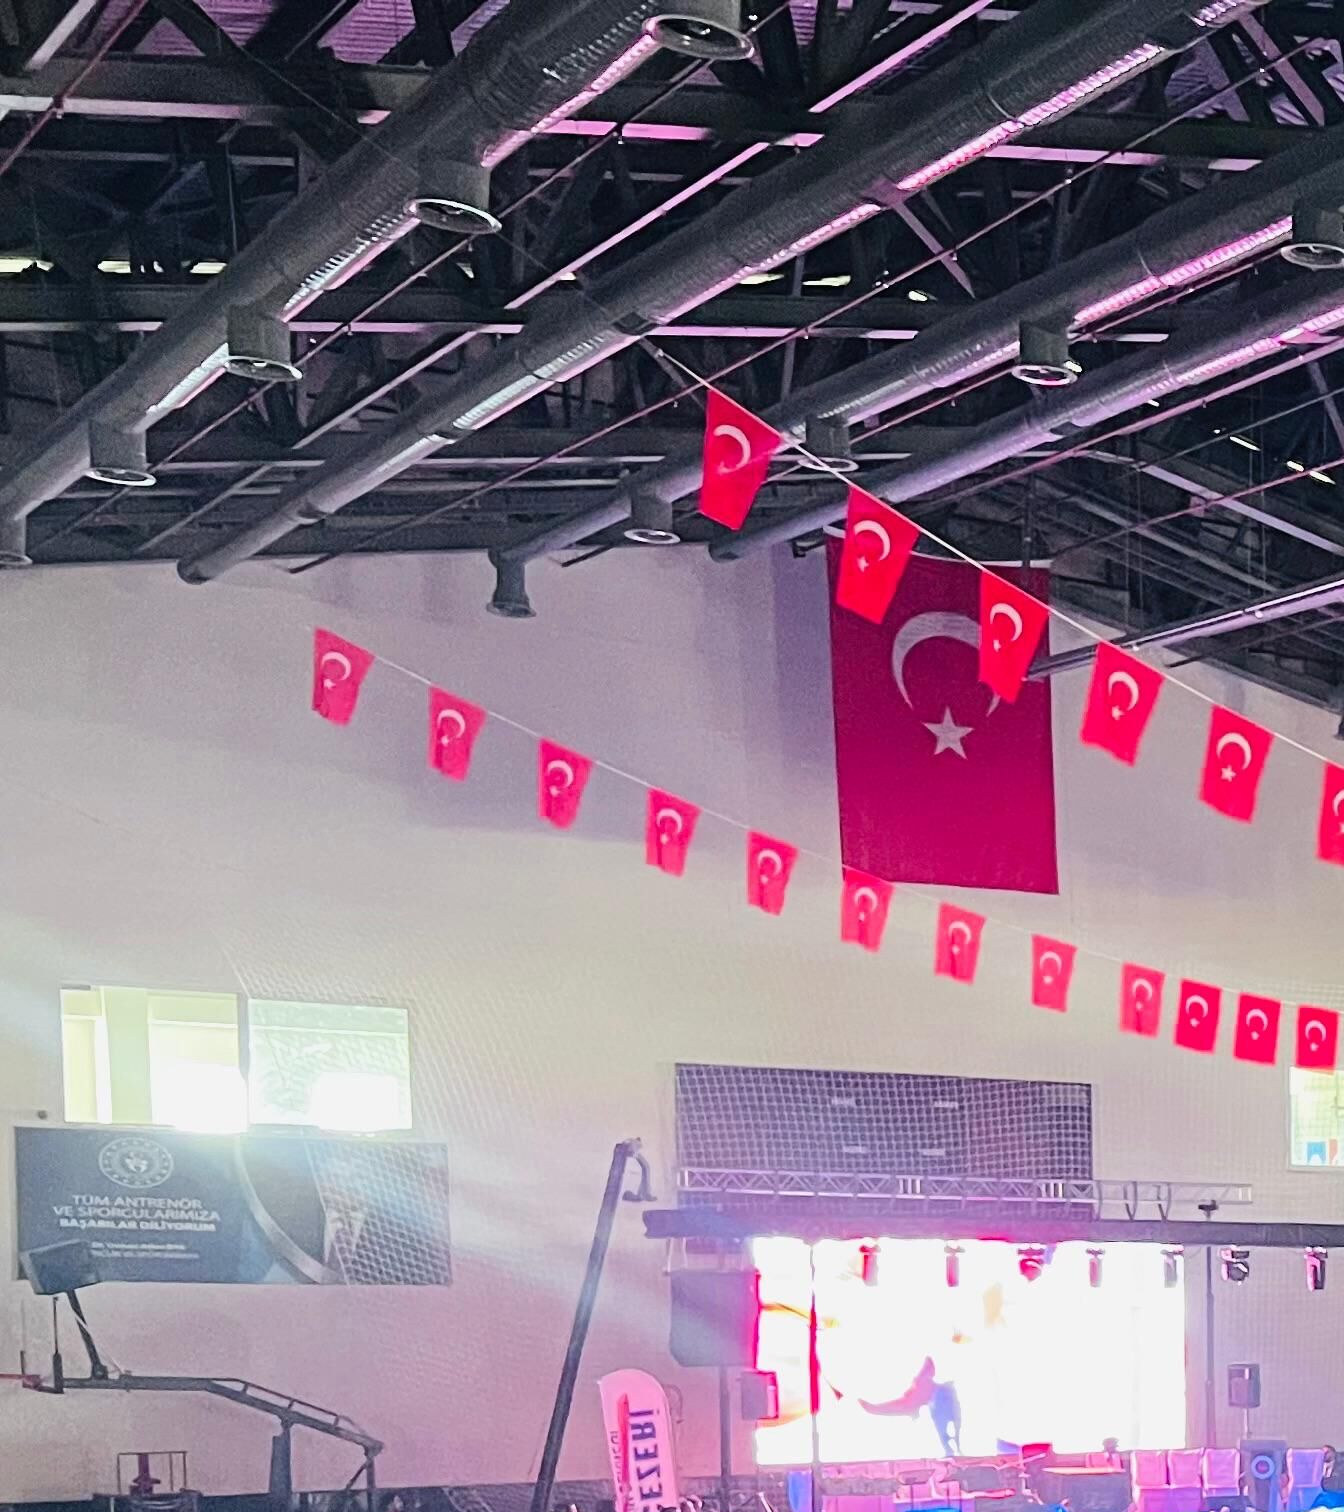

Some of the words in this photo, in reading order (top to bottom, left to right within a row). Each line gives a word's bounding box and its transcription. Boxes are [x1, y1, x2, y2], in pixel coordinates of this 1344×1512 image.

[114, 1195, 203, 1210] ANTRENÖR
[52, 1205, 74, 1217] VE
[77, 1205, 222, 1223] SPORCULARIMIZA
